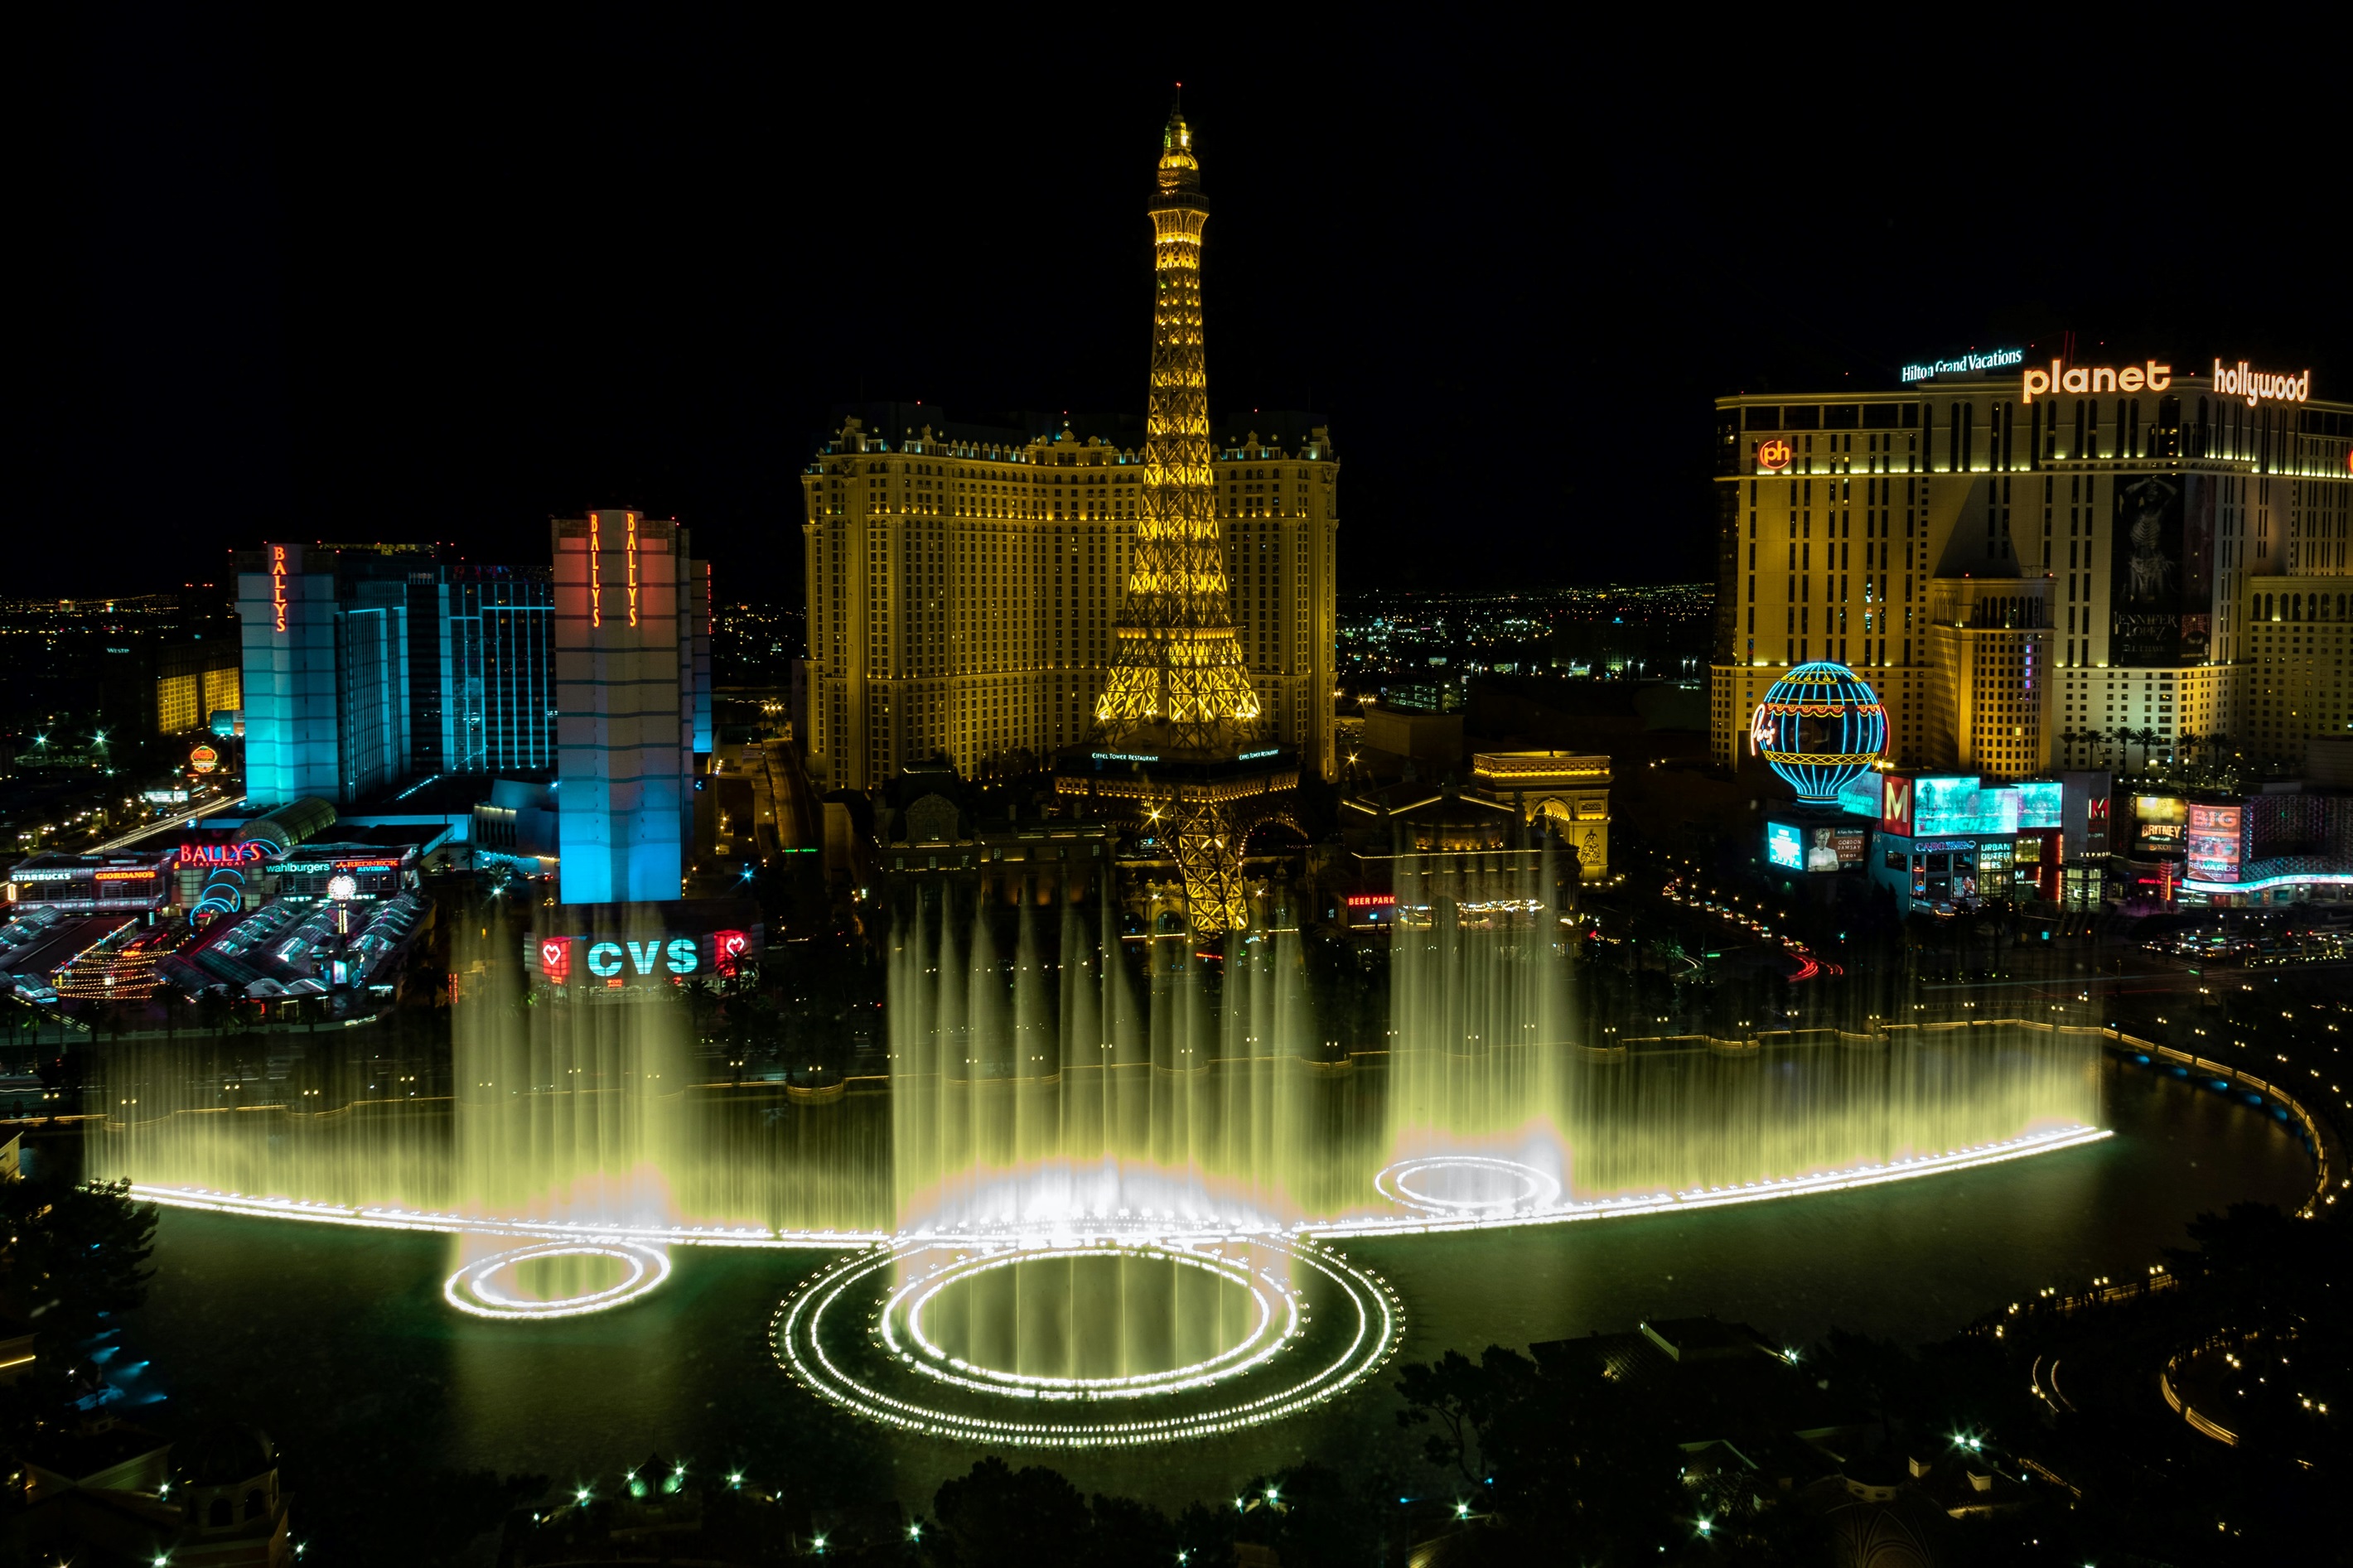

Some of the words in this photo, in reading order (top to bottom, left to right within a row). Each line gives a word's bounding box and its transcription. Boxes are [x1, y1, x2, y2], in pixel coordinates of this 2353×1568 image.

[1902, 364, 1934, 382] Hilton
[1935, 356, 1967, 372] Grand
[1969, 350, 2022, 369] Vacations
[2022, 359, 2171, 403] planet
[2214, 358, 2309, 407] hollywood
[1764, 440, 1790, 464] ph
[591, 514, 600, 628] BALLYS
[626, 513, 637, 627] BALLYS
[273, 547, 287, 632] BALLYS
[1886, 782, 1908, 823] M
[2088, 798, 2109, 819] M
[2142, 824, 2181, 838] BRITNEY
[181, 843, 261, 862] BALLY'S
[1915, 842, 1946, 852] CABO
[1981, 843, 2010, 852] URBAN
[95, 871, 156, 880] GIORDANO'S
[266, 863, 330, 873] wahlburgers
[2015, 871, 2025, 880] M
[2189, 862, 2238, 872] REWARDS
[12, 873, 71, 881] STARBUCKS
[1348, 897, 1370, 905] BEER
[1372, 896, 1395, 905] PARK
[587, 938, 698, 977] CVS
